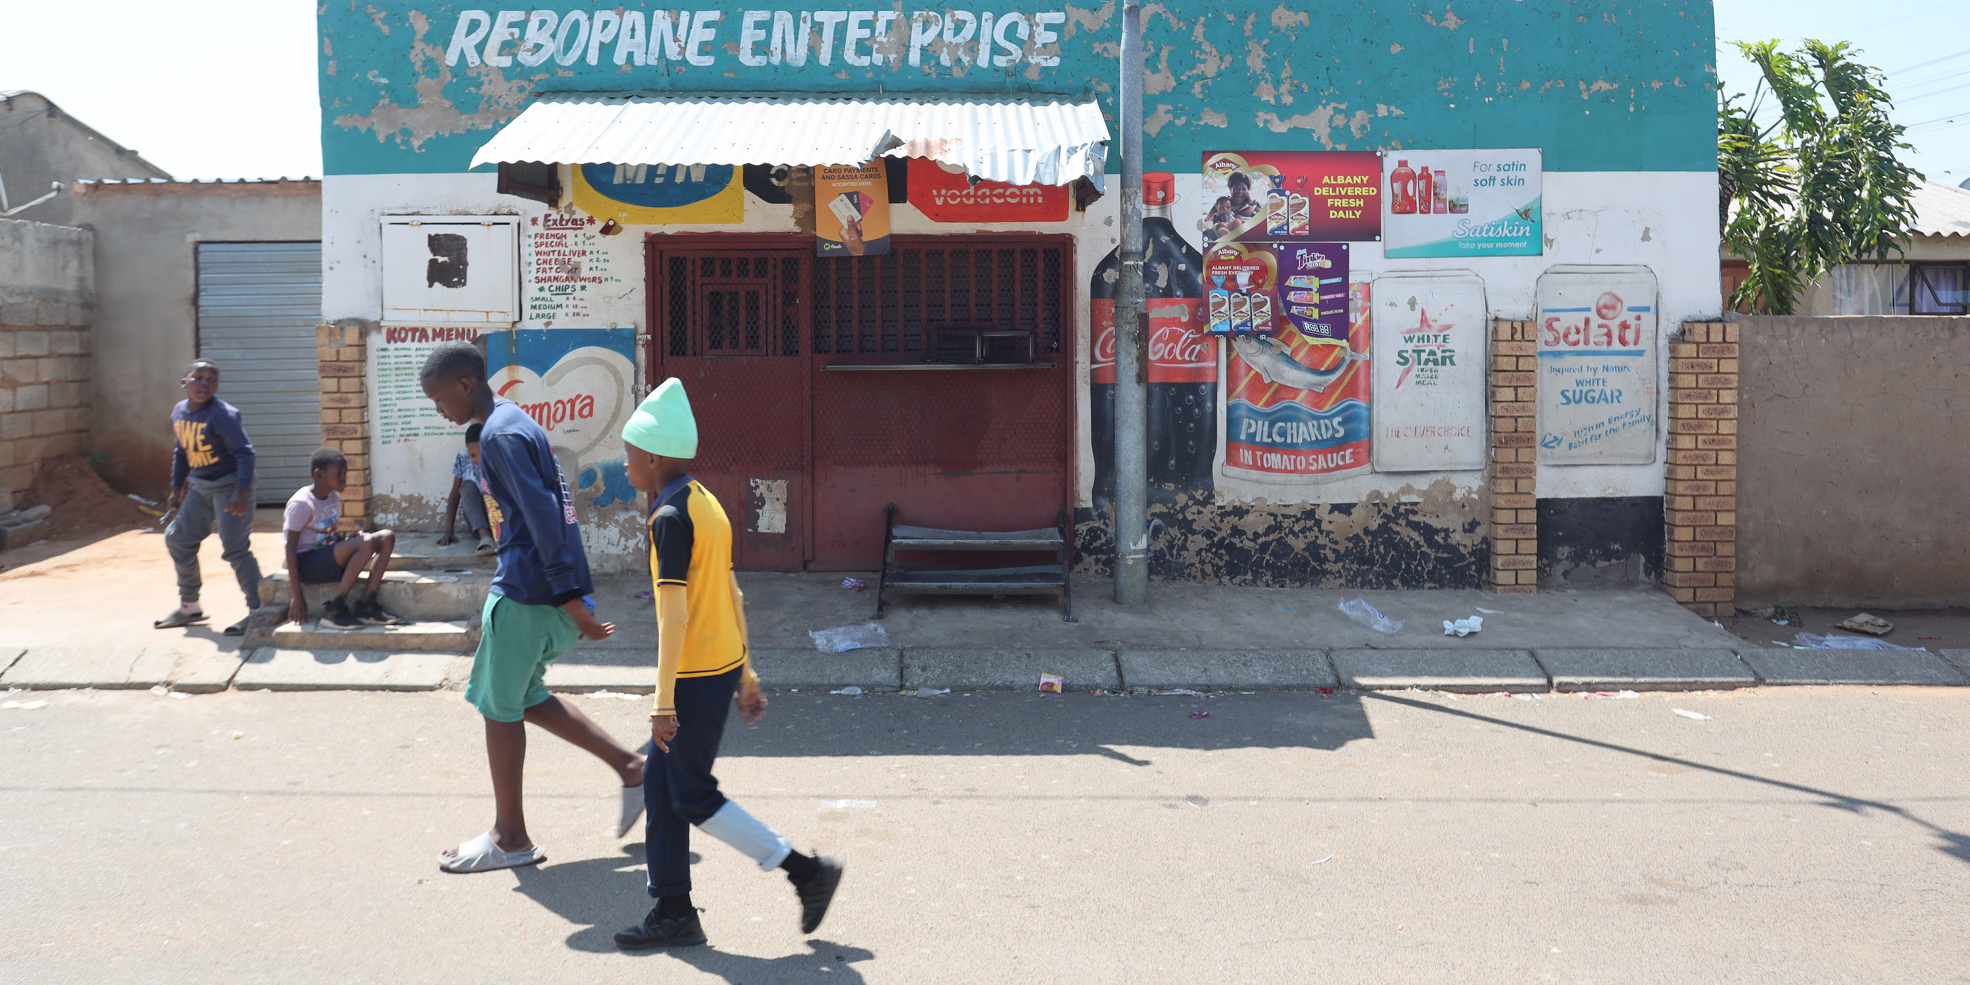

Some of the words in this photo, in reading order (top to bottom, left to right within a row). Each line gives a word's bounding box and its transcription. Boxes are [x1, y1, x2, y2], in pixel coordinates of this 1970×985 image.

[444, 9, 721, 68] REBOPANE
[1215, 161, 1238, 170] Albany
[1473, 161, 1494, 172] For
[1496, 160, 1527, 172] satin
[1322, 175, 1369, 184] ALBANY
[1473, 176, 1496, 187] soft
[1499, 175, 1525, 187] skin
[932, 186, 1043, 206] vodacom
[1313, 187, 1378, 196] DELIVERED
[1327, 198, 1364, 207] FRESH
[1329, 210, 1362, 219] DAILY
[543, 213, 585, 229] Extras
[1453, 218, 1532, 239] Satiskin
[1458, 241, 1476, 249] Take
[1477, 242, 1495, 250] your
[1218, 248, 1239, 256] Albany
[578, 276, 603, 284] WORS
[548, 284, 577, 292] CHIPS
[529, 312, 557, 320] LARGE
[385, 326, 430, 344] KOTA
[431, 327, 478, 342] MENU
[1544, 314, 1642, 347] Selati
[1148, 326, 1203, 362] Cola
[1403, 334, 1450, 344] WHITE
[1395, 349, 1456, 366] STAR
[1550, 365, 1583, 375] Inspired
[1586, 364, 1598, 376] by
[1602, 365, 1632, 373] Nature
[1575, 378, 1608, 387] WHITE
[1560, 388, 1623, 405] SUGAR
[1607, 407, 1642, 425] Energy
[1239, 416, 1345, 445] PILCHARDS
[1437, 426, 1472, 438] CHOICE
[1568, 437, 1588, 451] Food
[1590, 432, 1602, 443] for
[1605, 426, 1620, 437] the
[1622, 413, 1652, 430] Family
[1239, 449, 1254, 465] IN
[1255, 451, 1307, 470] TOMATO
[1308, 449, 1355, 471] SAUCE
